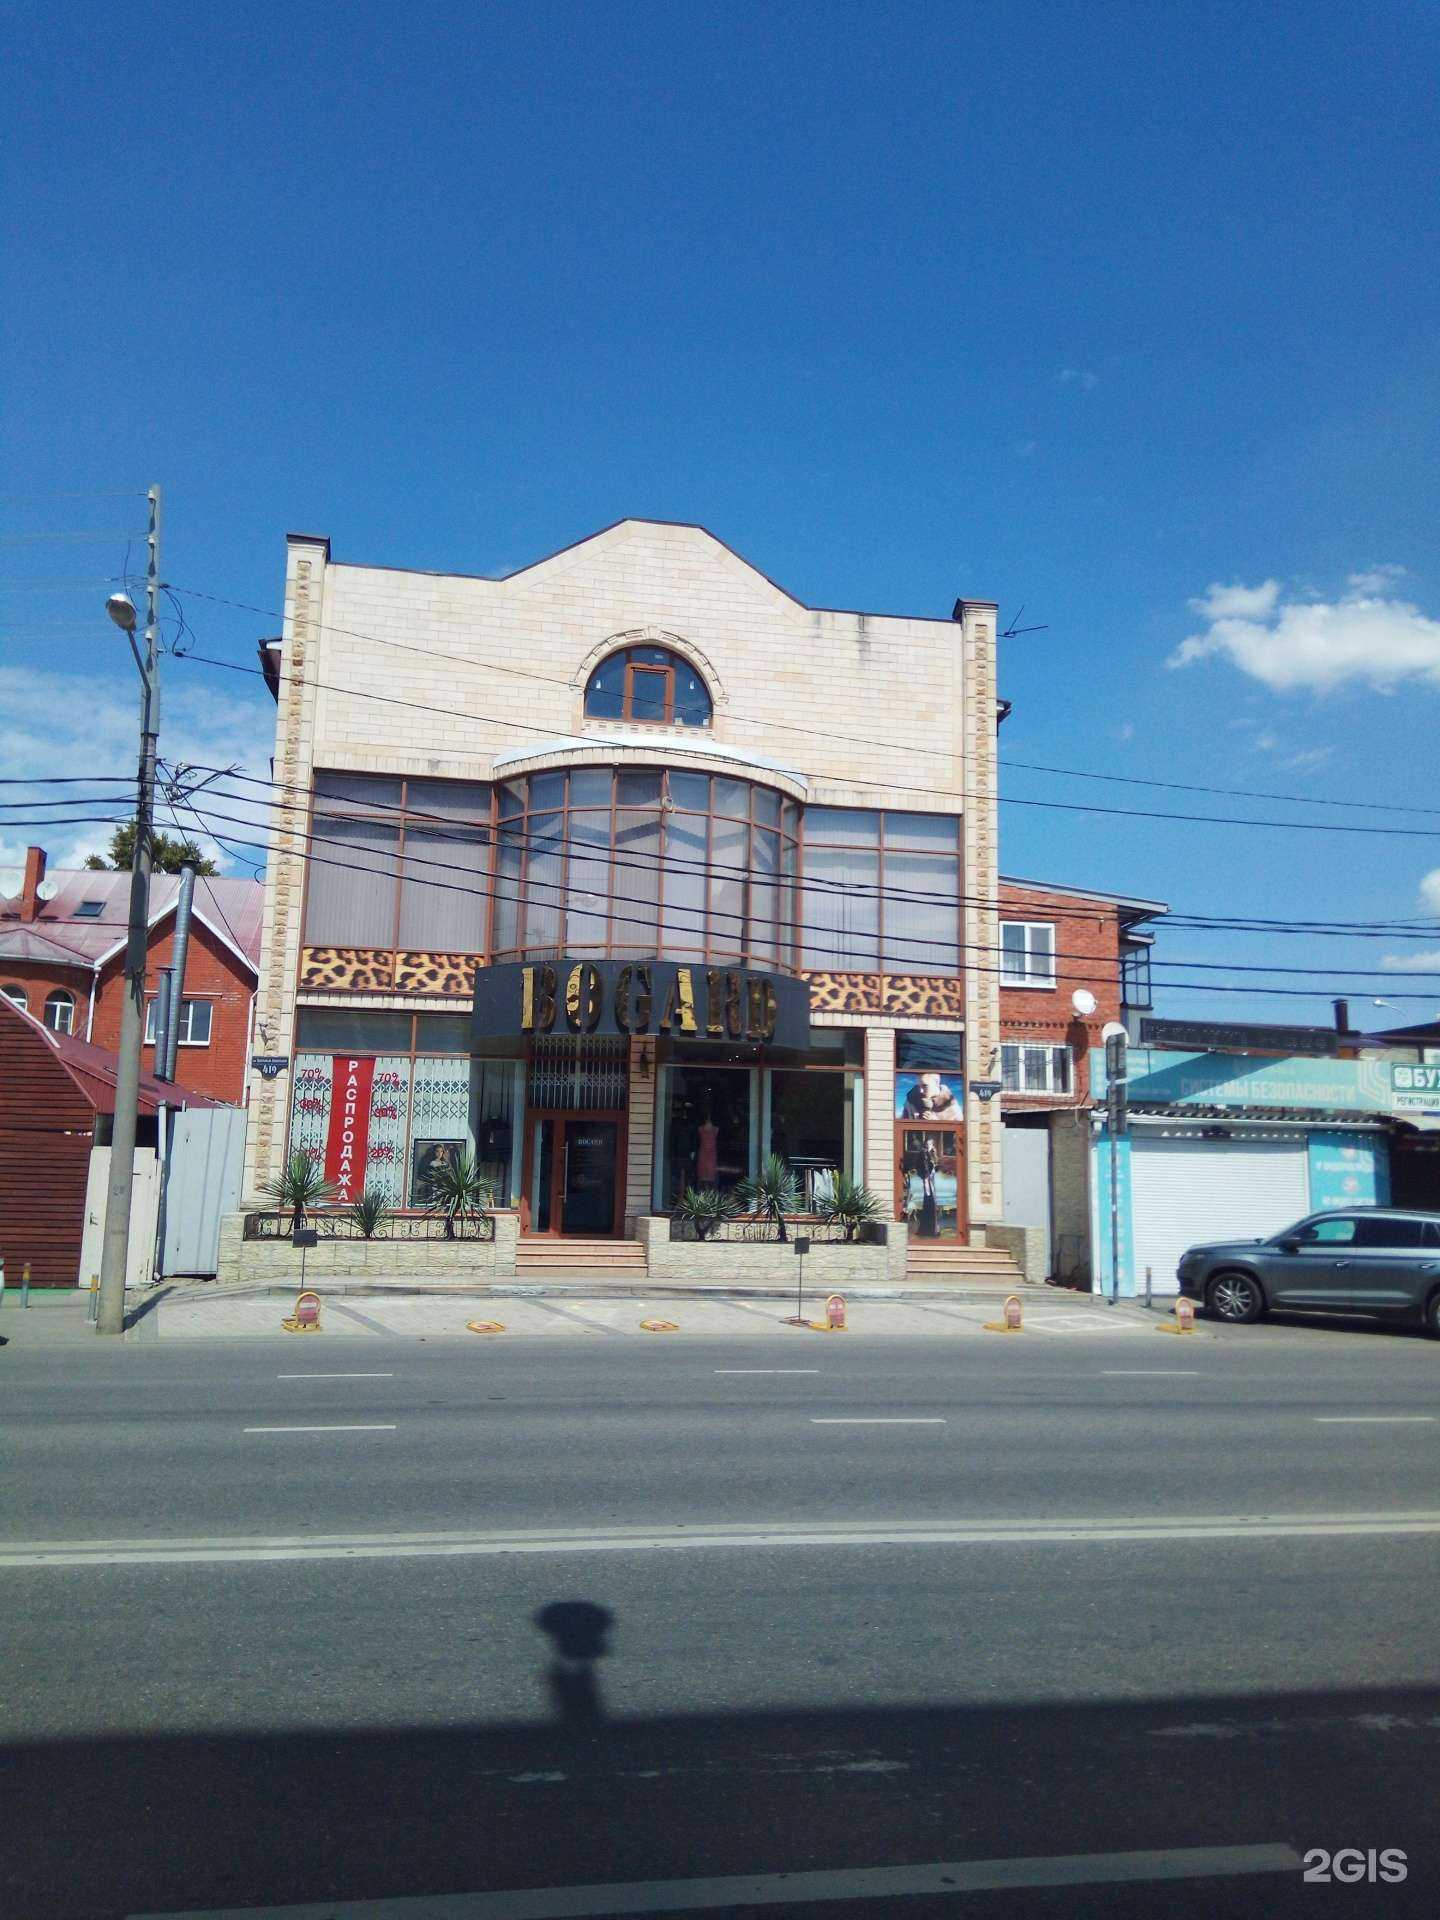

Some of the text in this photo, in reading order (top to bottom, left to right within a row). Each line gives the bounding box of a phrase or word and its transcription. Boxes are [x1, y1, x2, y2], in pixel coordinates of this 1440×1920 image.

[520, 963, 777, 1040] BOGARD
[263, 1064, 277, 1074] 419
[301, 1068, 325, 1082] 70%
[377, 1072, 400, 1087] 70%
[1180, 1078, 1357, 1103] СИСТЕМЫ БЕЗОПАСНОСТИ
[336, 1060, 359, 1201] РАСПРОДАЖА
